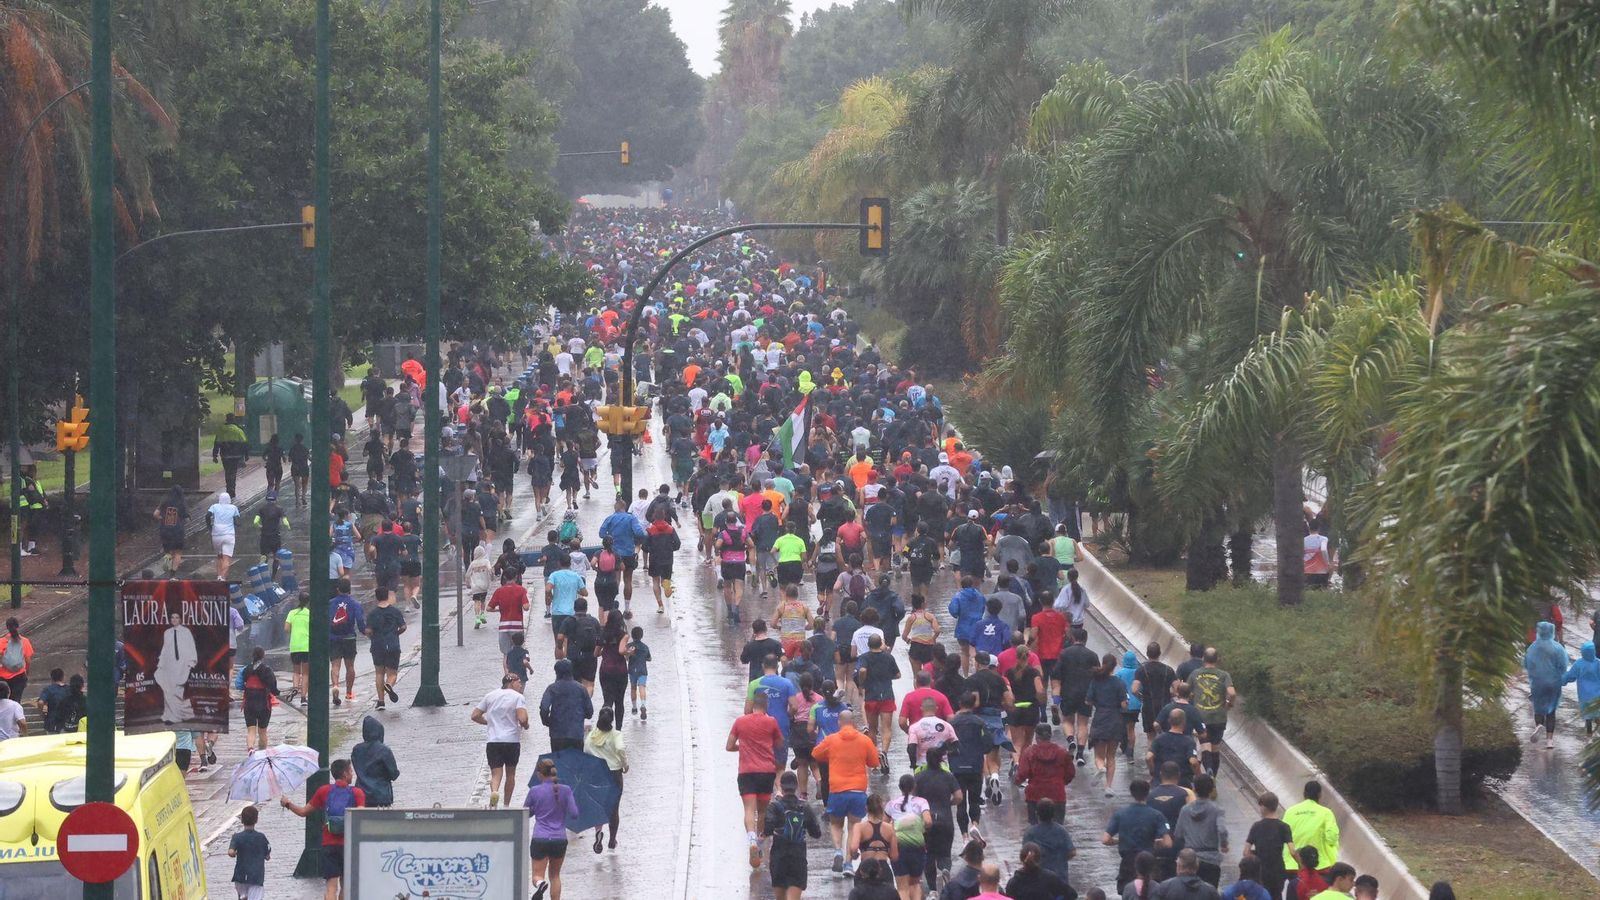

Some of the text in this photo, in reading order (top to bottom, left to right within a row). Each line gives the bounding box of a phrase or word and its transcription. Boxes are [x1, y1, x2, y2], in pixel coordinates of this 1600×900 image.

[123, 600, 228, 626] LAURA PAUSINI
[136, 672, 145, 681] 05
[397, 854, 473, 874] Carrera
